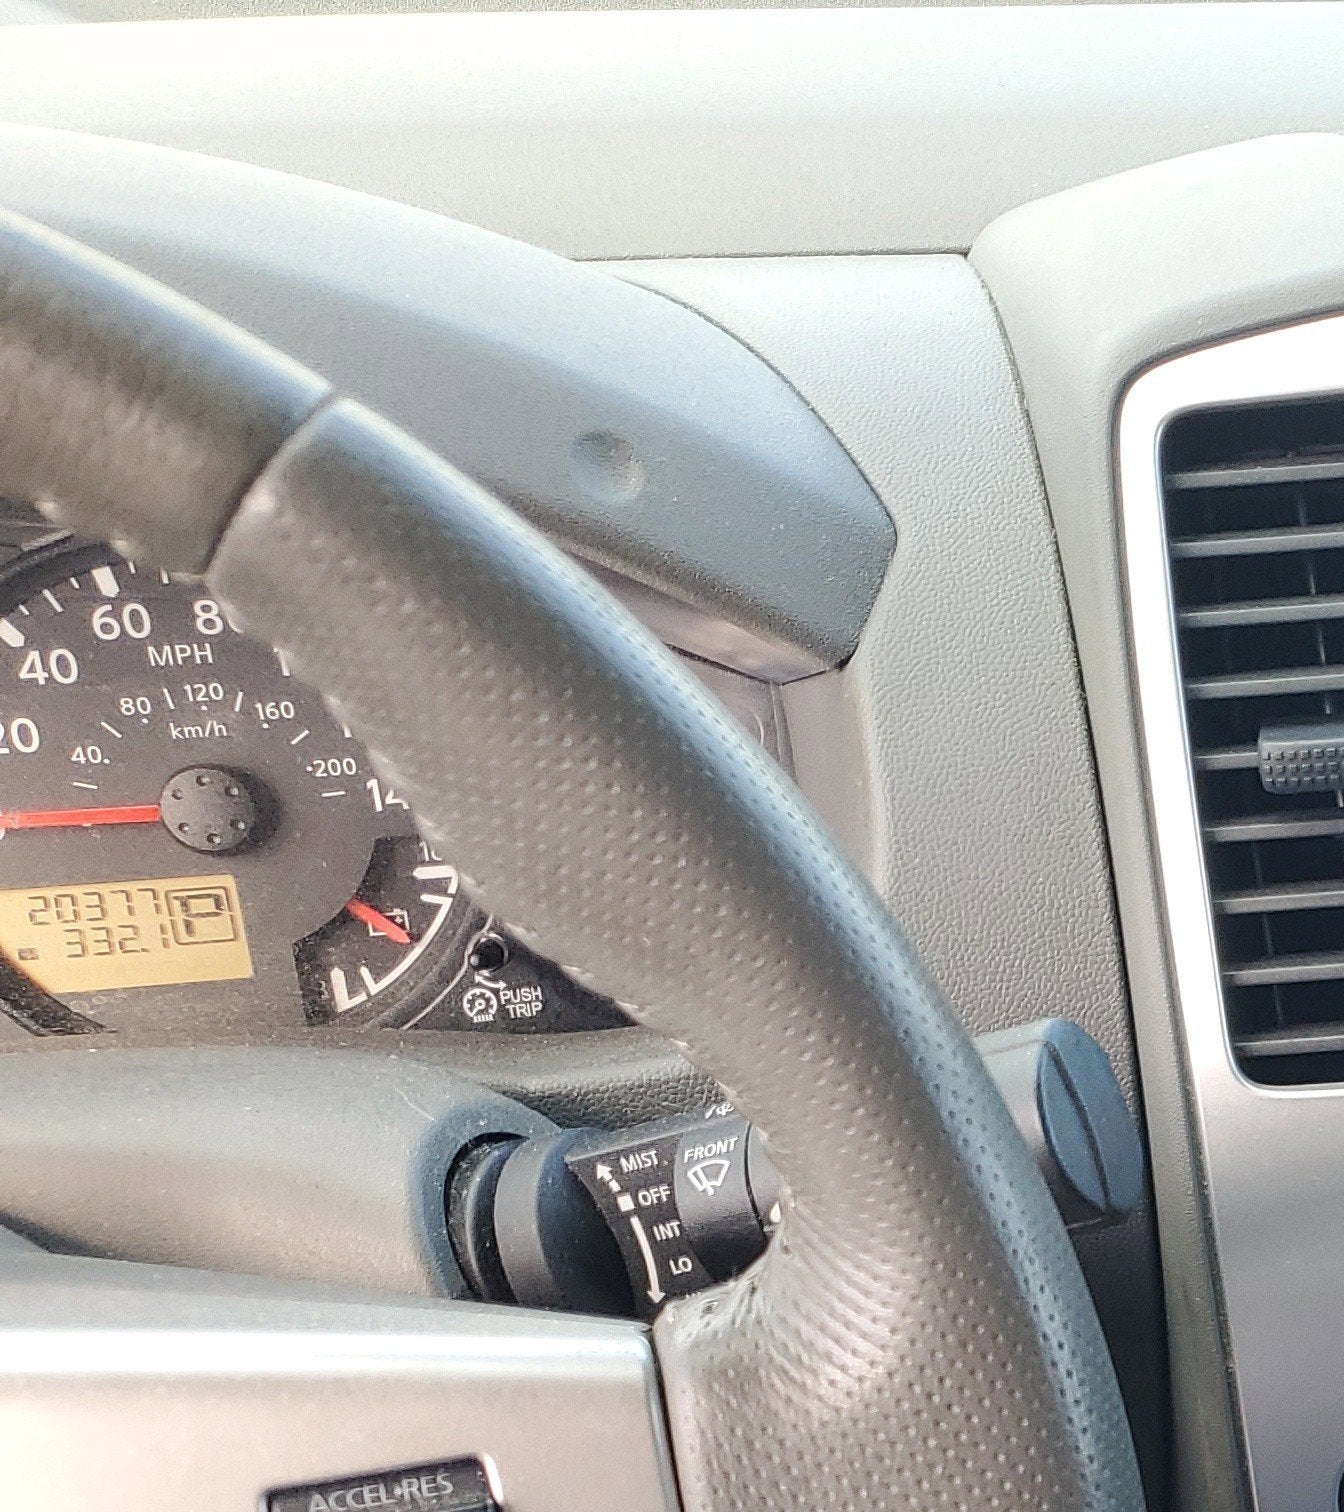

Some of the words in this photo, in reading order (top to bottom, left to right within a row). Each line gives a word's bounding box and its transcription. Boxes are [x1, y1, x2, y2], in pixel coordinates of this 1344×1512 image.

[92, 604, 150, 640] 60
[193, 599, 244, 634] 8
[147, 643, 214, 667] MPH
[18, 649, 78, 685] 40
[184, 682, 224, 701] 120
[119, 697, 150, 715] 80
[254, 701, 295, 720] 160
[169, 720, 227, 740] km/h
[71, 746, 102, 764] 40
[312, 757, 357, 778] 200
[27, 887, 163, 925] 20377
[172, 893, 225, 937] P
[500, 986, 543, 1004] PUSH
[505, 1002, 543, 1019] TRIP
[684, 1137, 739, 1162] FRONT
[621, 1151, 659, 1172] MIST
[638, 1186, 671, 1206] OFF
[653, 1221, 681, 1241] INT
[669, 1257, 693, 1275] LO
